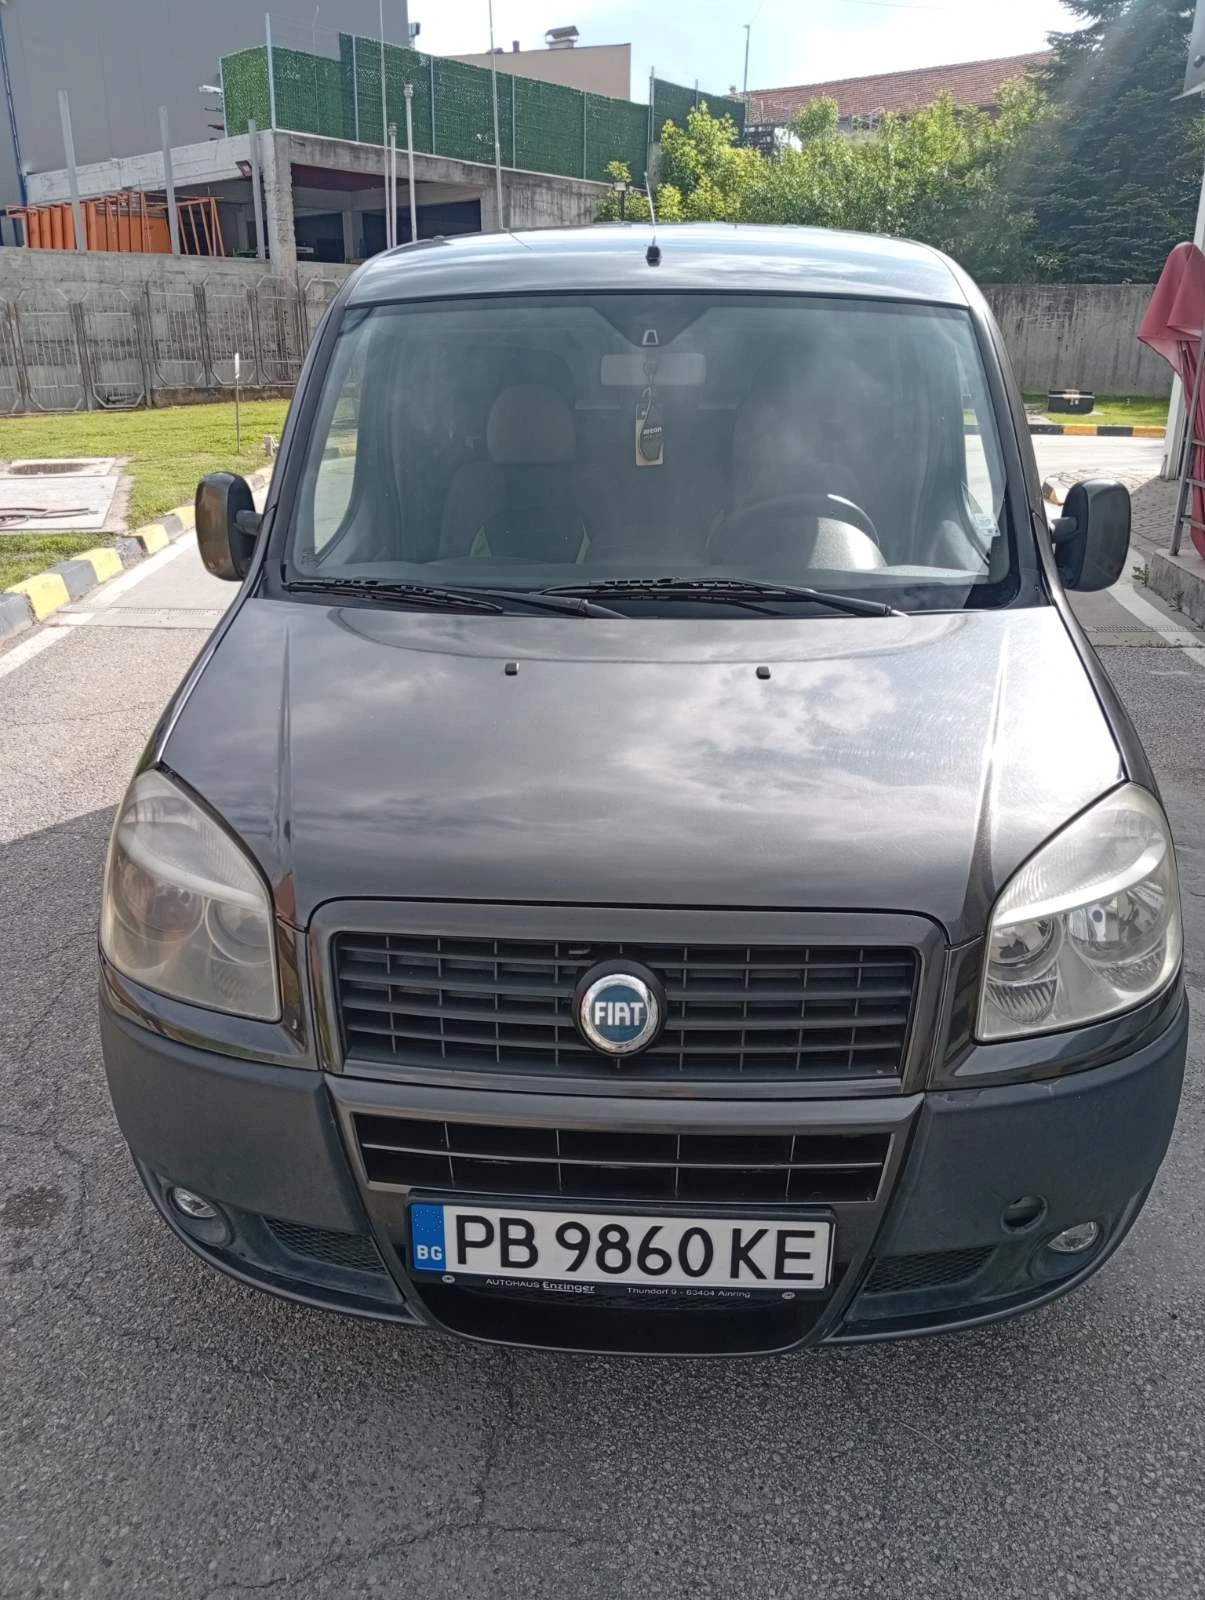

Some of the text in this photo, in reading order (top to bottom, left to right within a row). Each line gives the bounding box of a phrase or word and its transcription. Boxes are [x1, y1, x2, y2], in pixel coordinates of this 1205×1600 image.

[594, 1002, 644, 1026] FIAT
[416, 1244, 443, 1261] BG
[456, 1214, 815, 1281] PB 9860 KE
[486, 1278, 596, 1293] AUTOHAUS Enzinger
